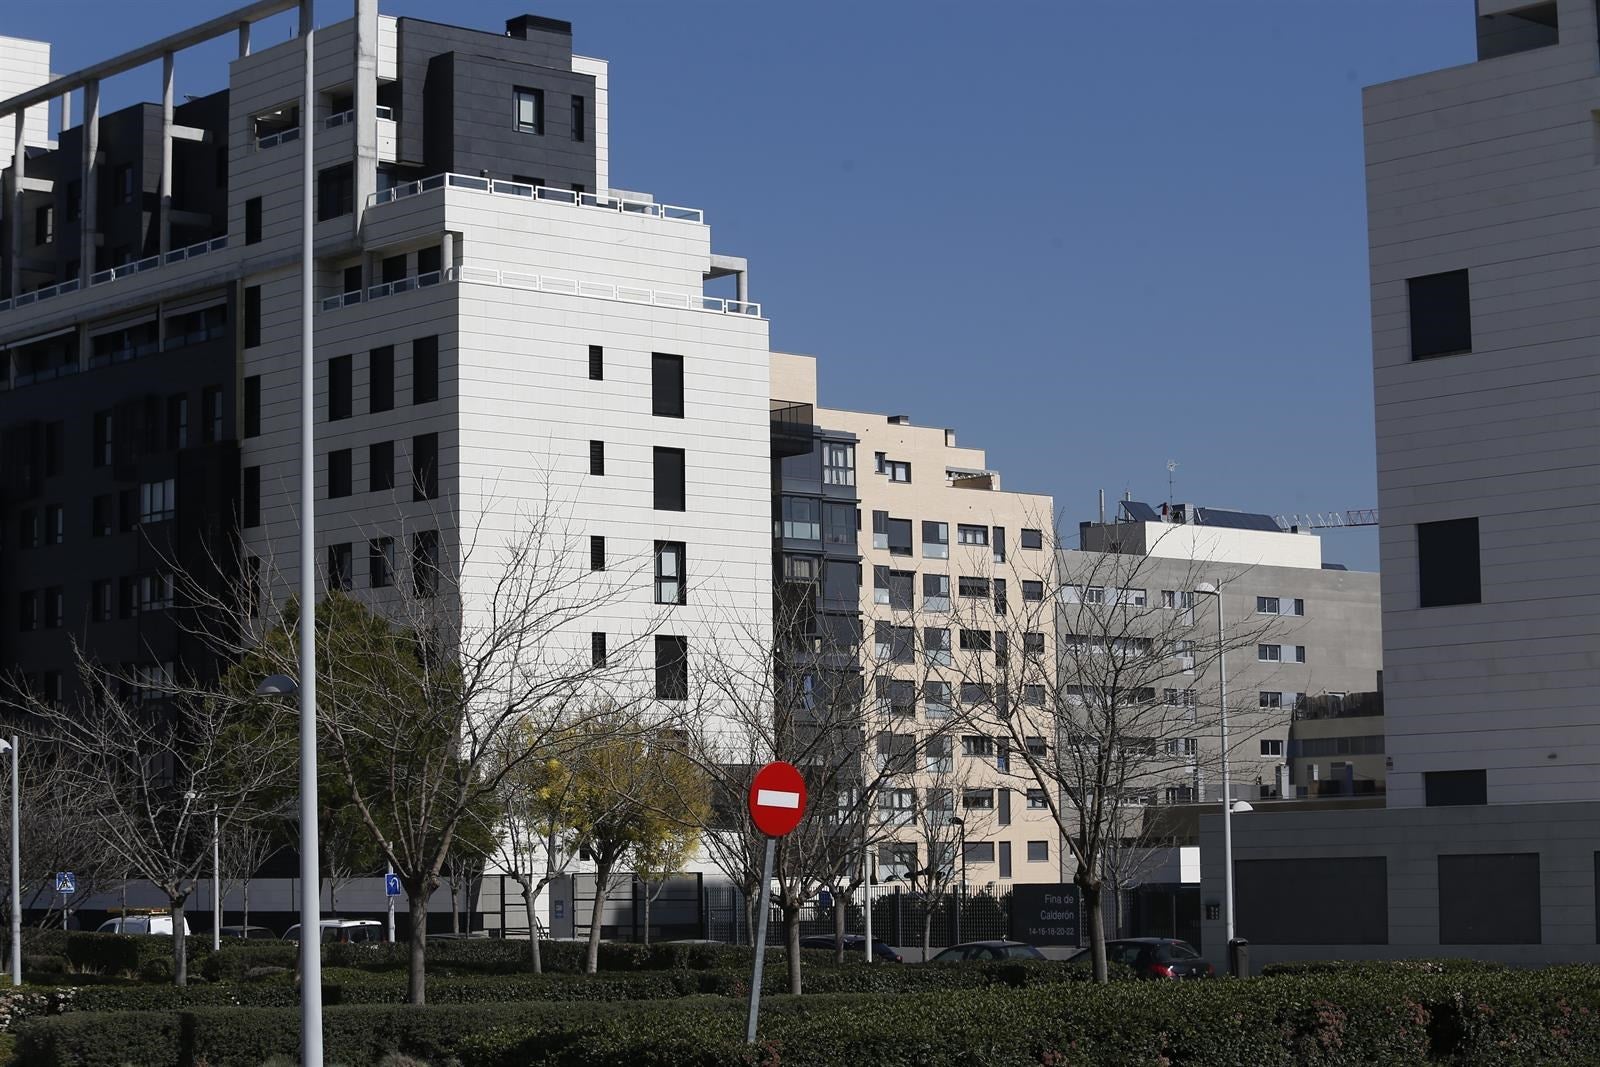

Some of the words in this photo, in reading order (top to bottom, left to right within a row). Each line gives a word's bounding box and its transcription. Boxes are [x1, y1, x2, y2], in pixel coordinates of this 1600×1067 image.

[1044, 894, 1062, 904] Fina
[1063, 894, 1074, 904] de
[1040, 910, 1074, 920] Calderón
[1028, 927, 1074, 936] 14-16-18-20-22
